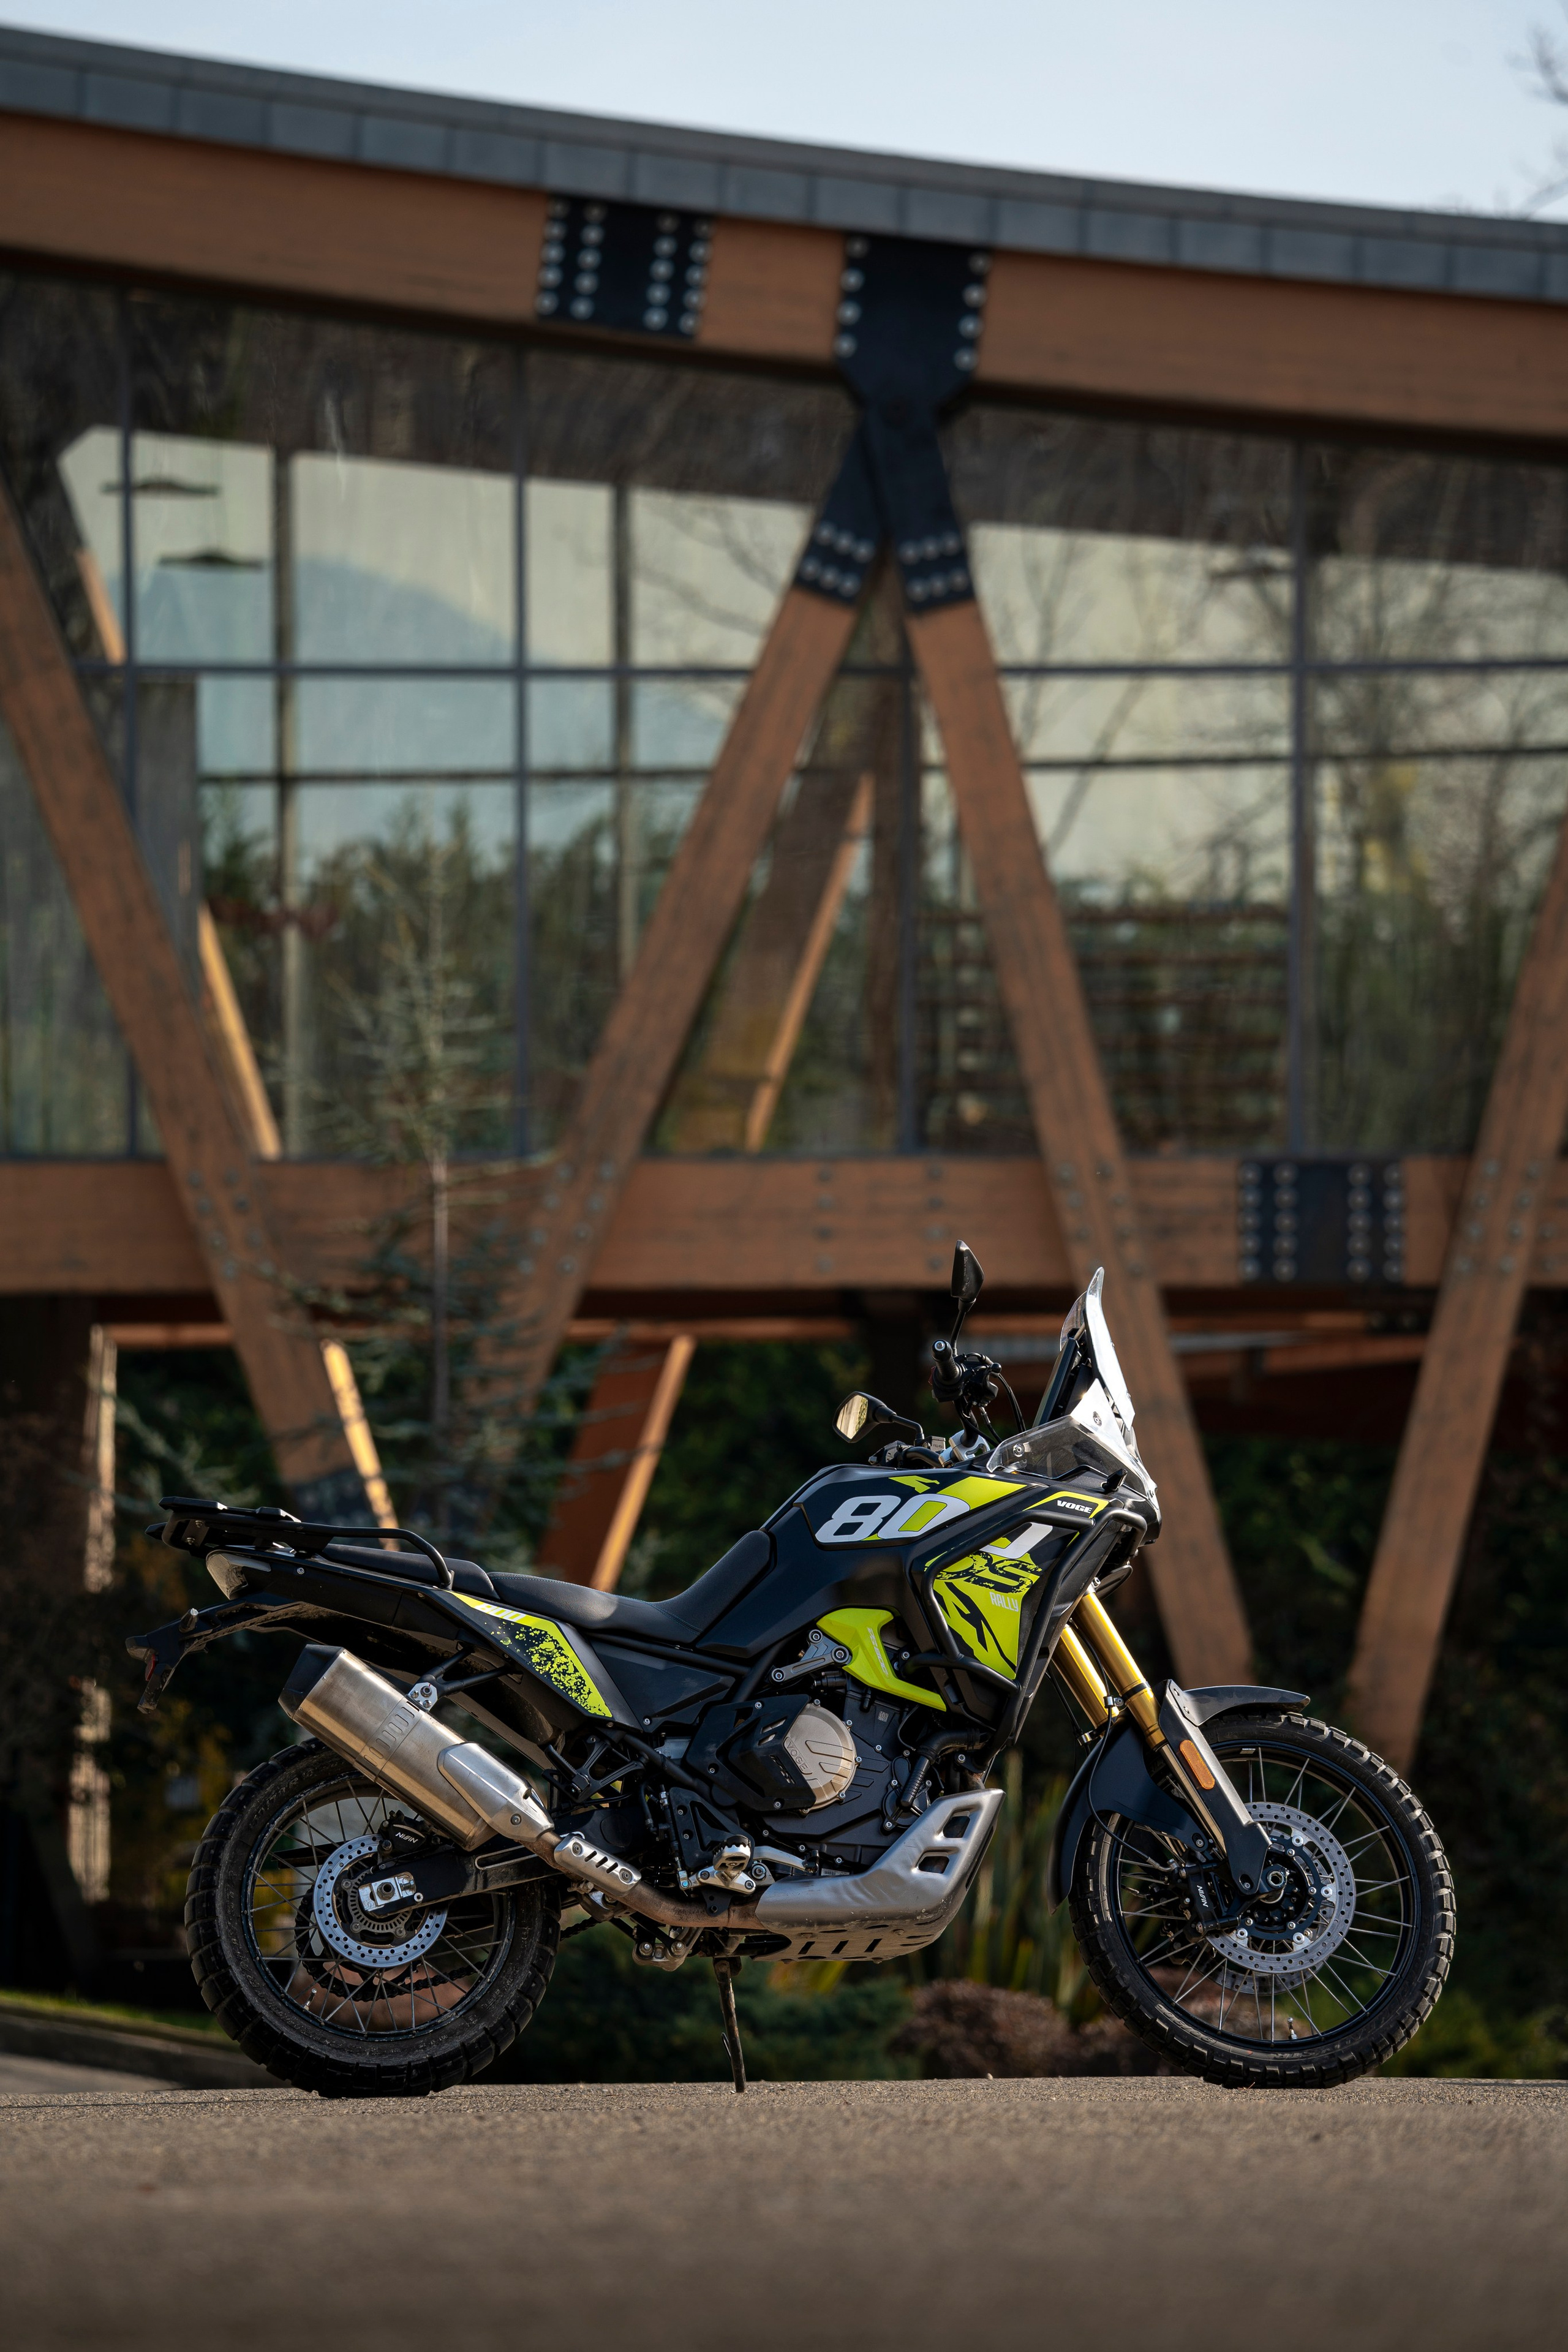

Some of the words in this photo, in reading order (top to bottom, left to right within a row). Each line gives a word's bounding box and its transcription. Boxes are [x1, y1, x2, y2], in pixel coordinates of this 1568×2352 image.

[1056, 1499, 1093, 1513] VOGE
[990, 1591, 1019, 1612] RALLY
[473, 1602, 527, 1622] 800
[786, 1741, 809, 1771] VOGE
